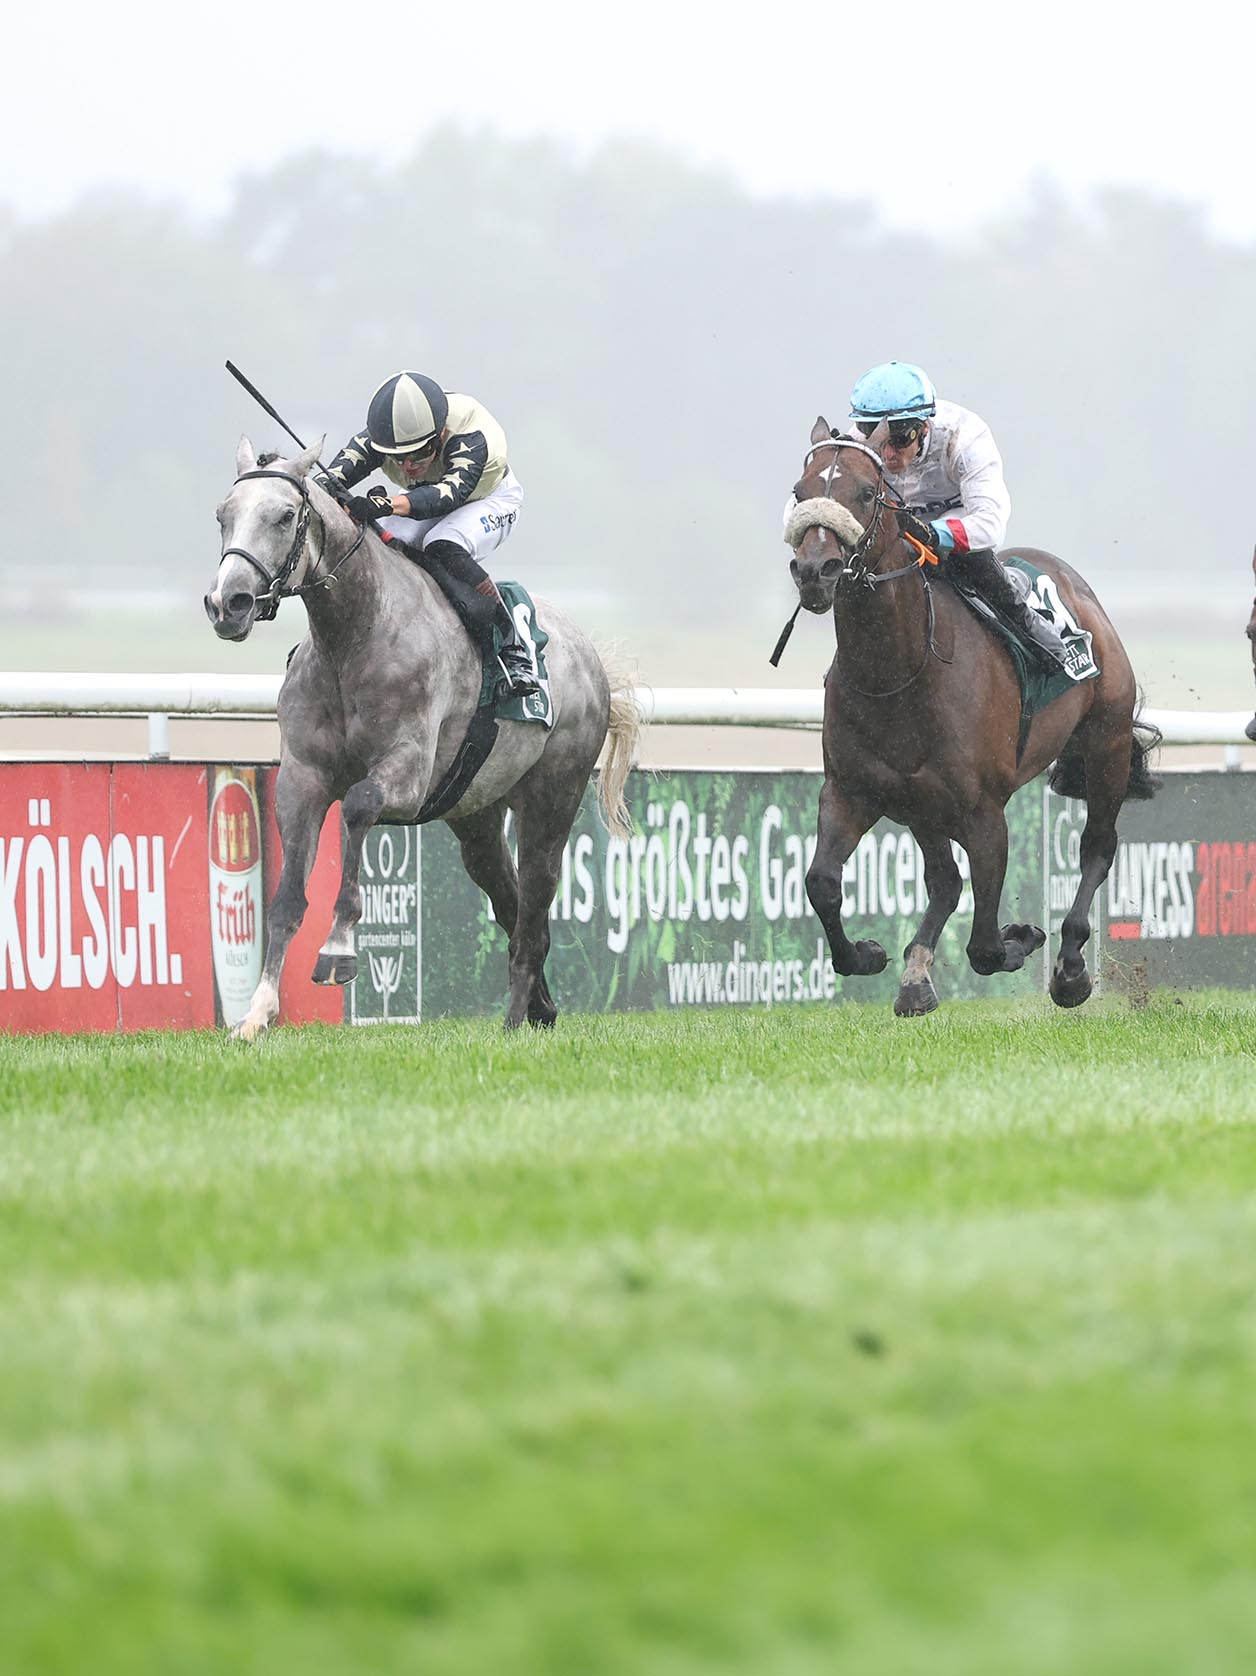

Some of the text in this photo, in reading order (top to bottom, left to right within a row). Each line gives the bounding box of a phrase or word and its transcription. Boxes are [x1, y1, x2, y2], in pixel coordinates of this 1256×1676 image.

[1068, 653, 1090, 672] STAR
[606, 800, 750, 954] größtes
[1107, 842, 1195, 939] LANXESS
[667, 937, 837, 1006] www.dingers.de
